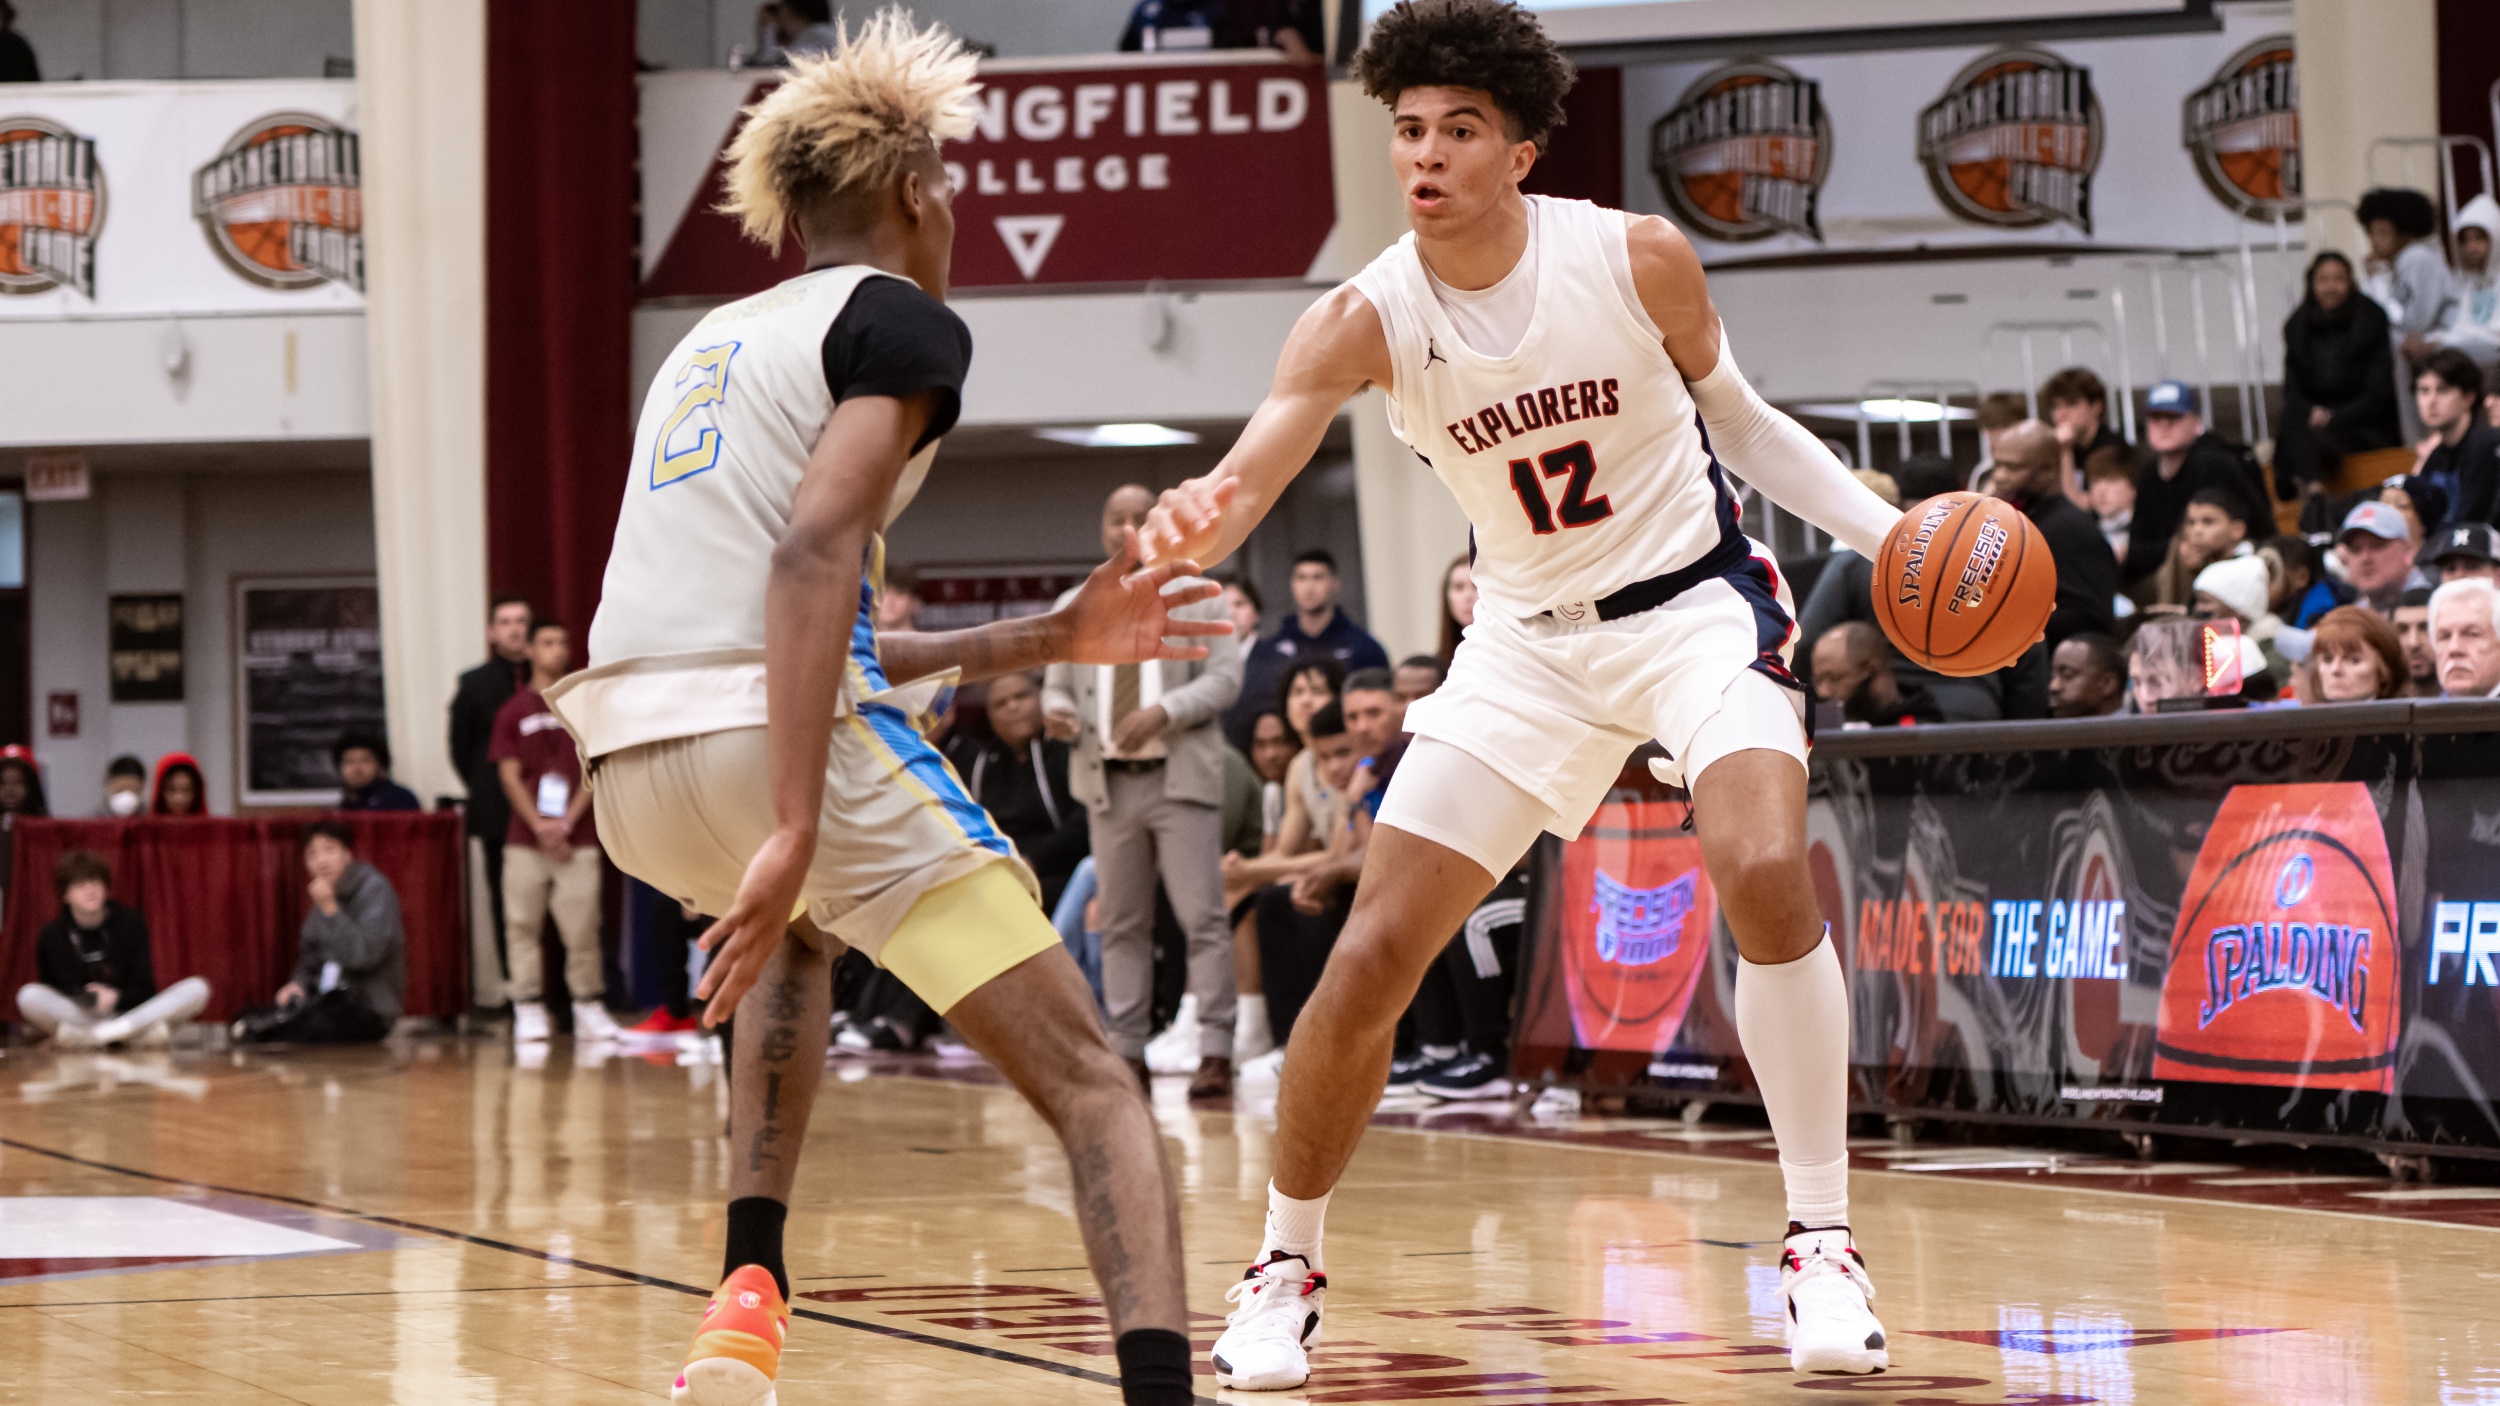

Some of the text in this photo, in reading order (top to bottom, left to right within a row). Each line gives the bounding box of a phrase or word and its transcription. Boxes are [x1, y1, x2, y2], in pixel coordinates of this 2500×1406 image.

[650, 341, 742, 491] 2
[1446, 378, 1620, 455] EXPLORERS
[1508, 439, 1614, 536] 12
[1898, 498, 1965, 610] SPALDING
[1948, 514, 2001, 616] PRECISION
[1979, 527, 2008, 585] 1000
[1856, 898, 2129, 980] MADE FOR THE GAME.
[2199, 921, 2372, 1034] SPALDING
